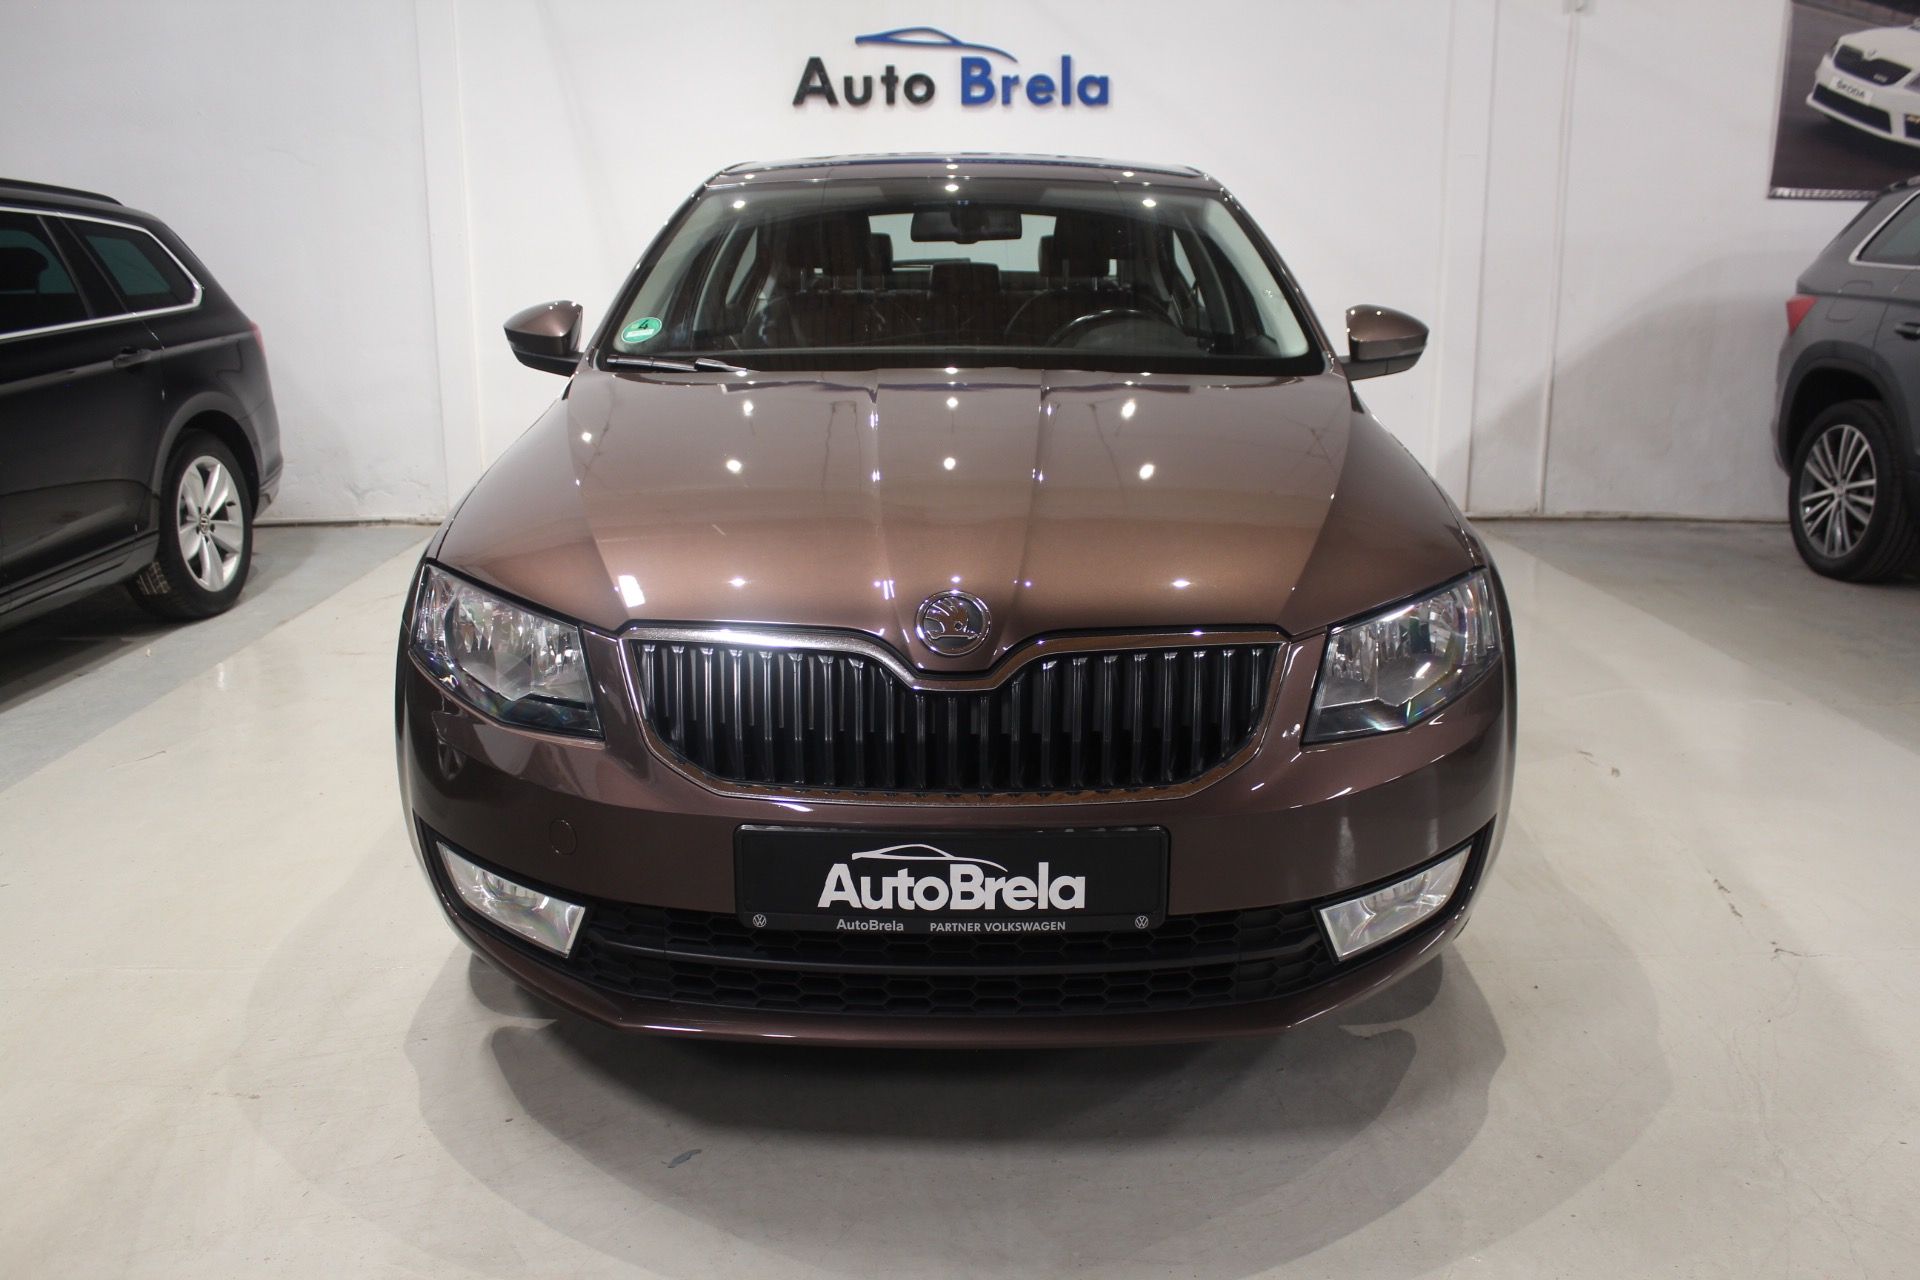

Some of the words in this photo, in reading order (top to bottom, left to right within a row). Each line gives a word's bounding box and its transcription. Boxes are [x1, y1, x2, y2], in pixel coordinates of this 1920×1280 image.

[793, 56, 937, 107] Auto
[960, 55, 1110, 107] Brela
[817, 861, 1087, 911] AutoBrela
[836, 918, 905, 932] AutoBrela
[929, 922, 982, 932] PARTNER
[984, 921, 1067, 932] VOLKSWAGEN
